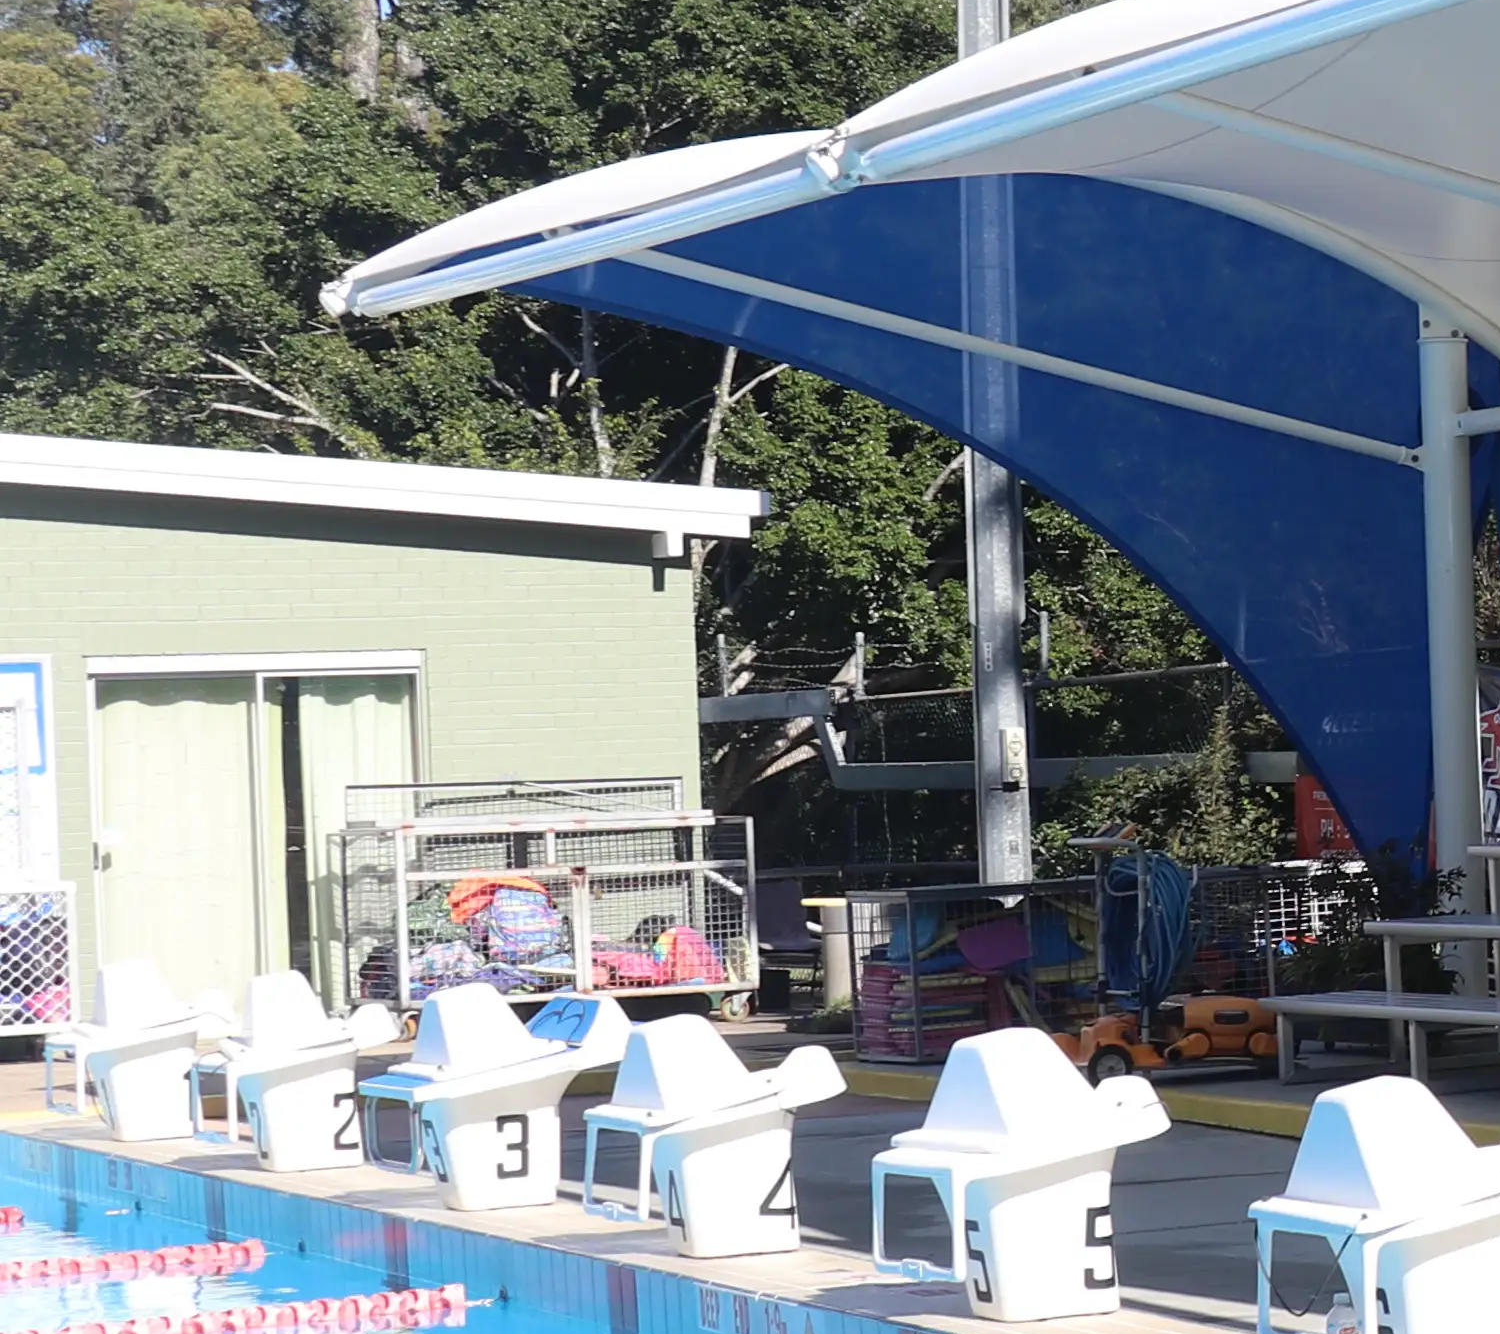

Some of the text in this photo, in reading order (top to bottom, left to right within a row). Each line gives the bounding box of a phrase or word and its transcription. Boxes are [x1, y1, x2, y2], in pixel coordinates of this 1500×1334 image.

[333, 1092, 360, 1150] 2
[421, 1119, 448, 1183] 3
[496, 1113, 528, 1179] 3
[667, 1170, 687, 1242] 4
[759, 1157, 797, 1229] 4
[964, 1219, 992, 1304] 5
[1084, 1204, 1115, 1289] 5
